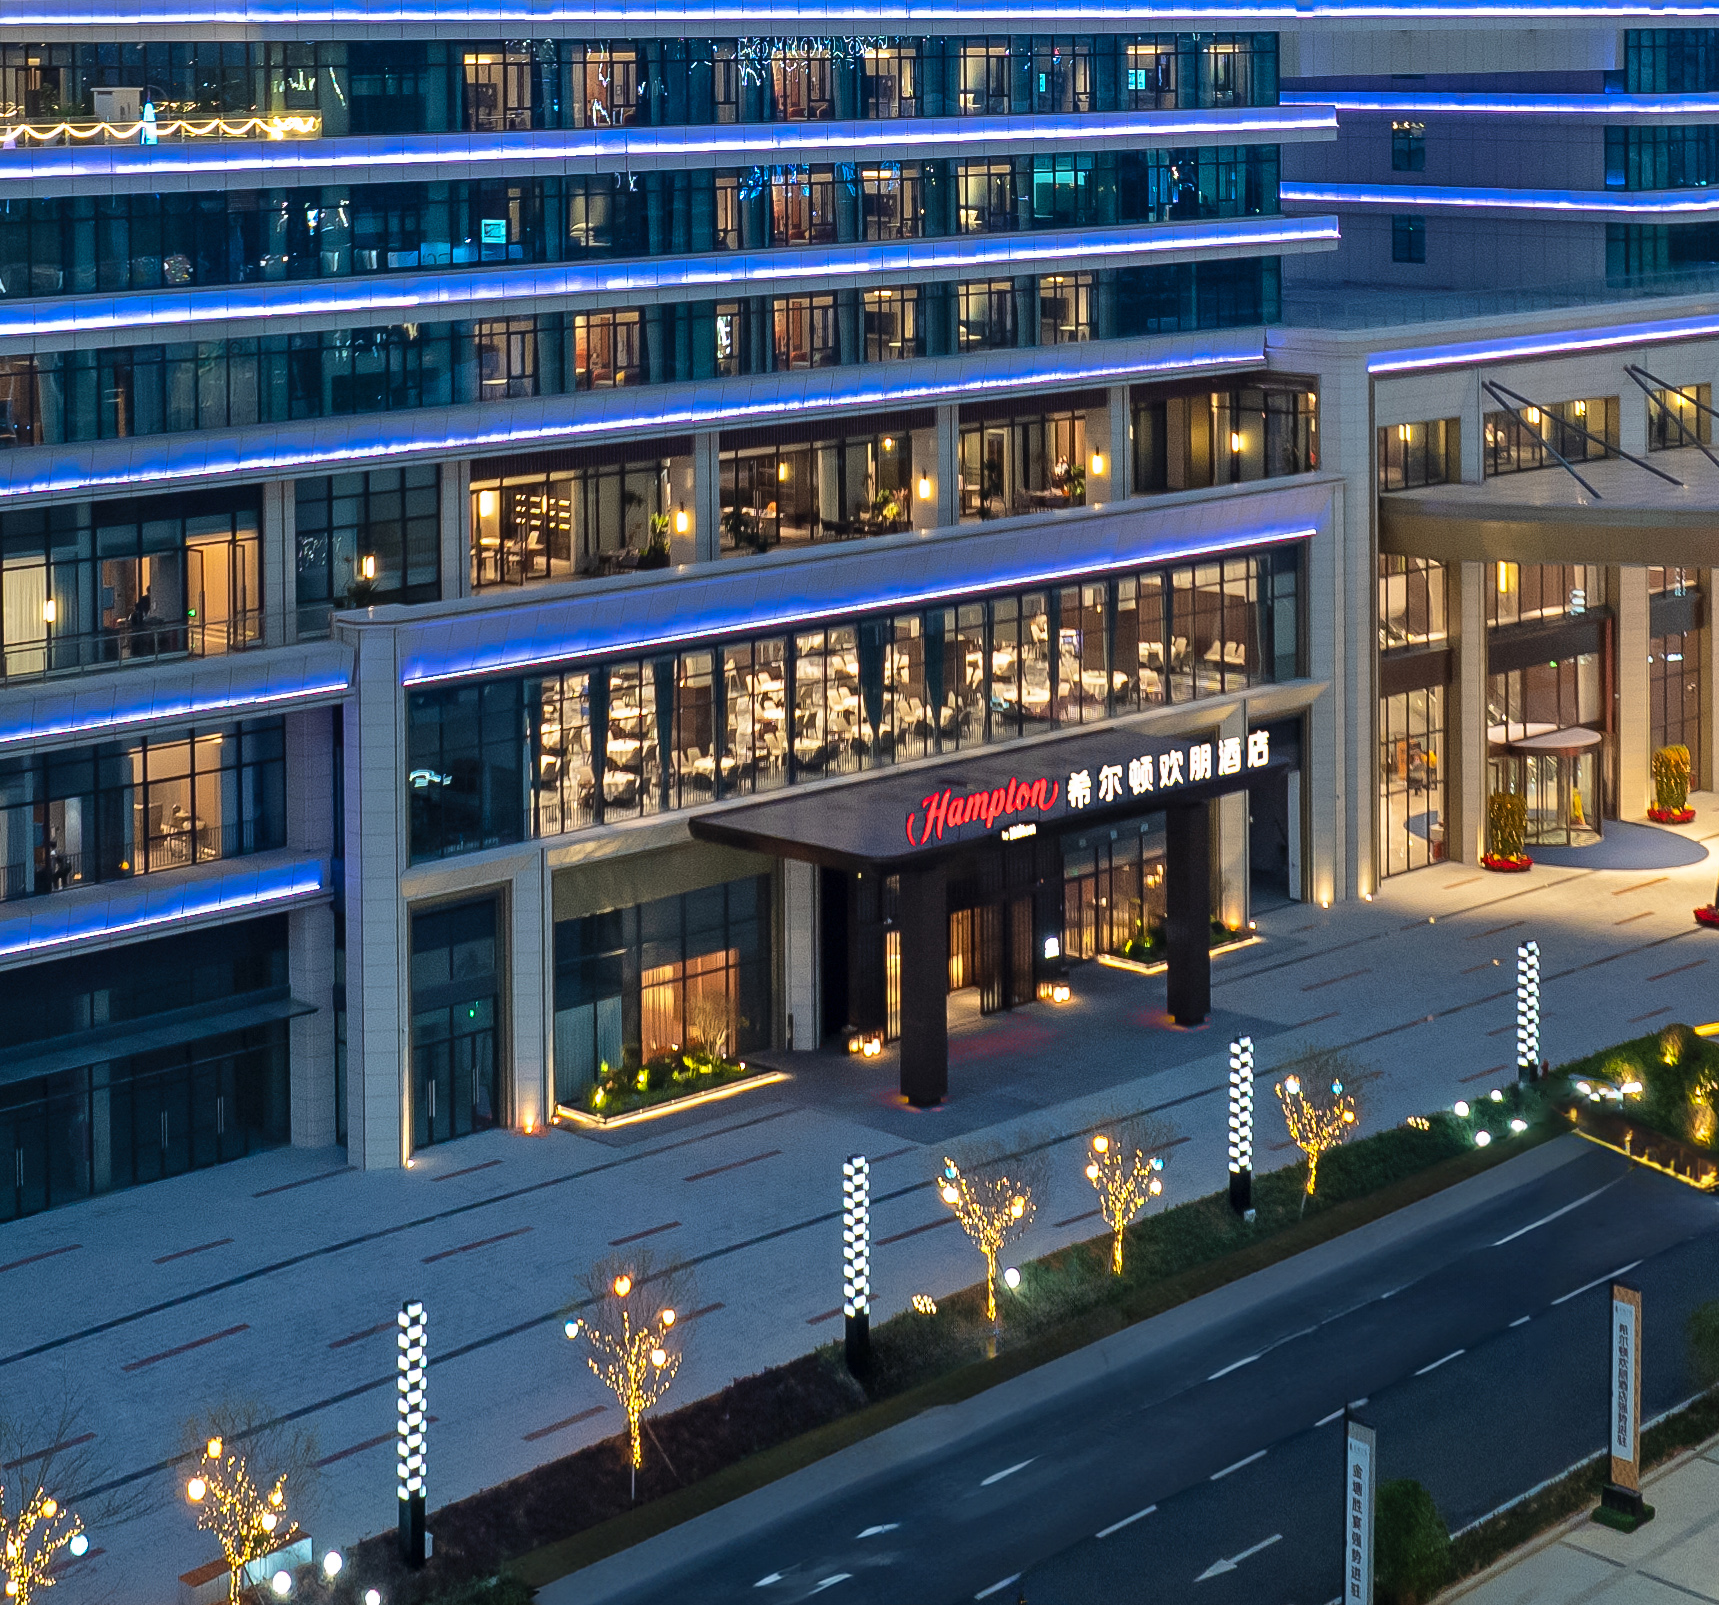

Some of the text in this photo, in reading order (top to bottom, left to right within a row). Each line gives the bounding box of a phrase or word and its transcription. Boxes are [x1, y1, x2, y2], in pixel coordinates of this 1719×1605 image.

[1067, 729, 1270, 810] 希尔顿欢朋酒店
[906, 777, 1059, 847] Hampton
